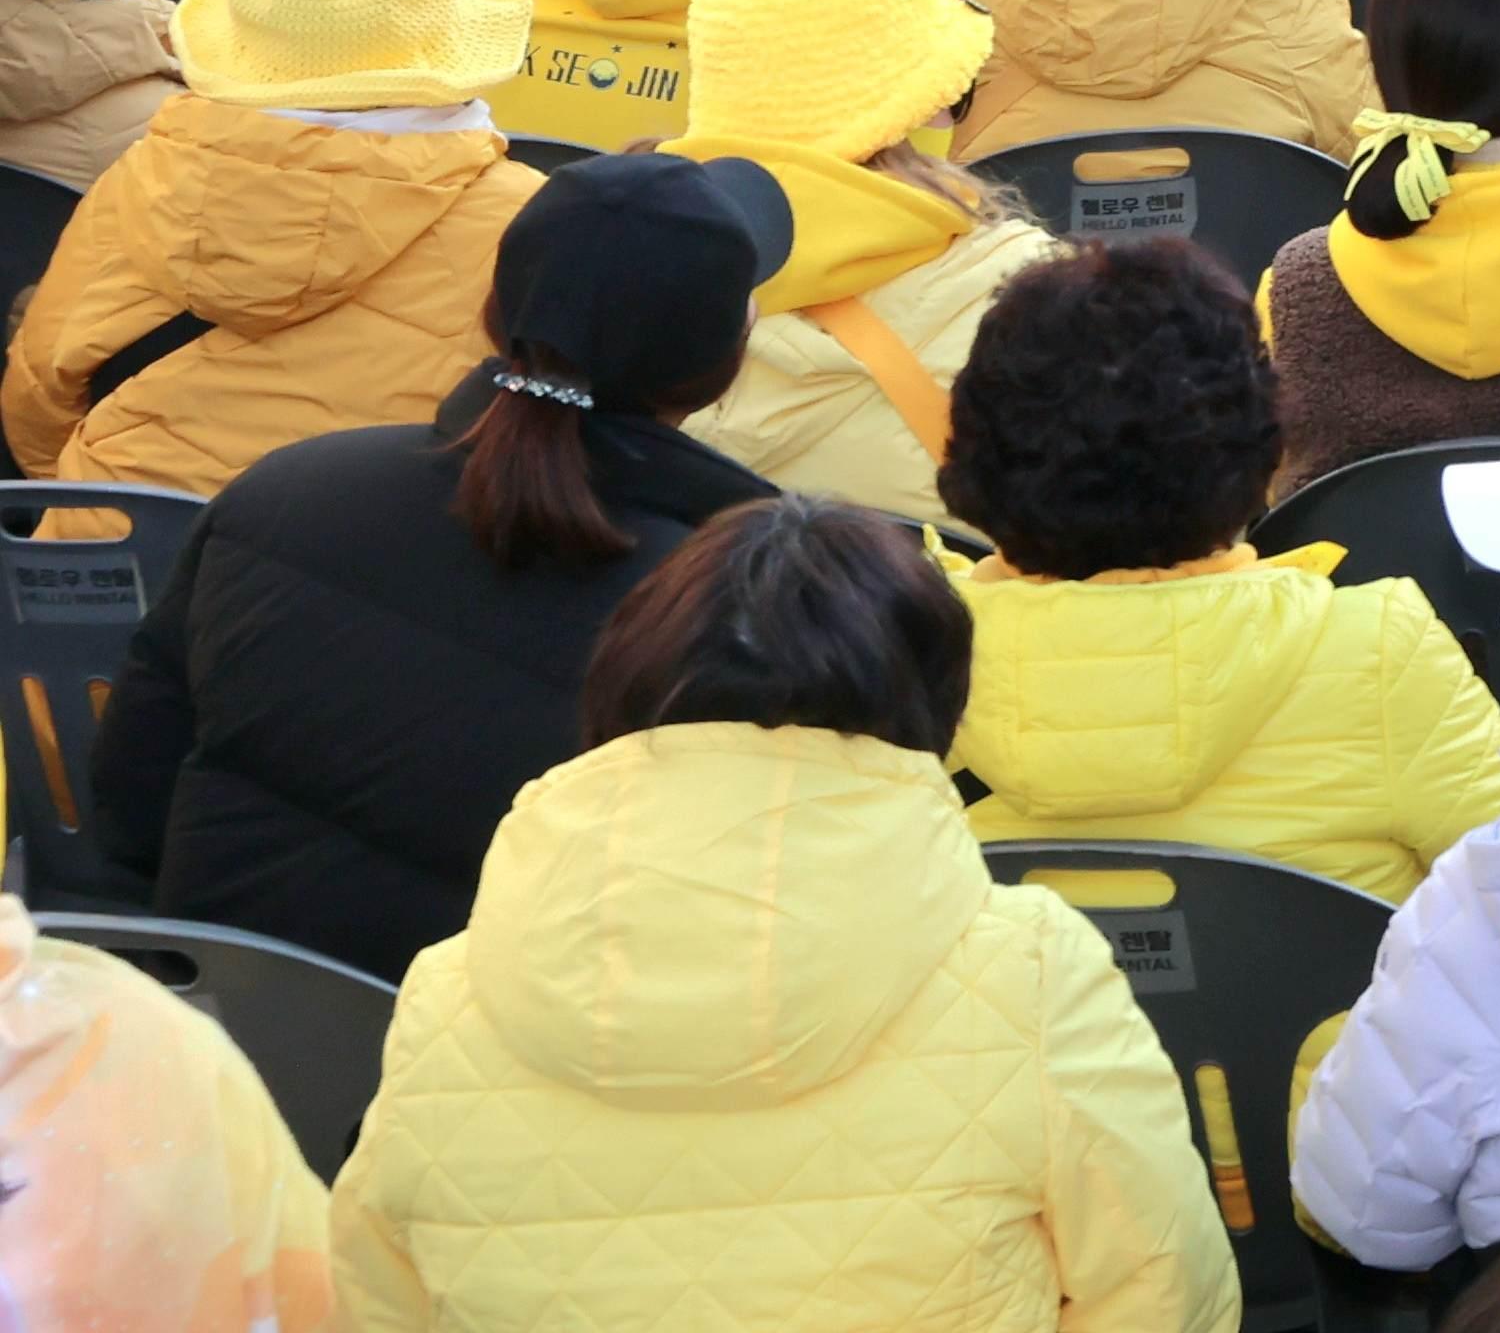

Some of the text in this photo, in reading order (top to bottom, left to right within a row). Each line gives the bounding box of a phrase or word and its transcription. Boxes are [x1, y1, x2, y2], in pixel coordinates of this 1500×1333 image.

[626, 65, 681, 103] JIN
[1081, 193, 1184, 215] 헬로우 렌탈
[1120, 931, 1172, 952] 렌탈
